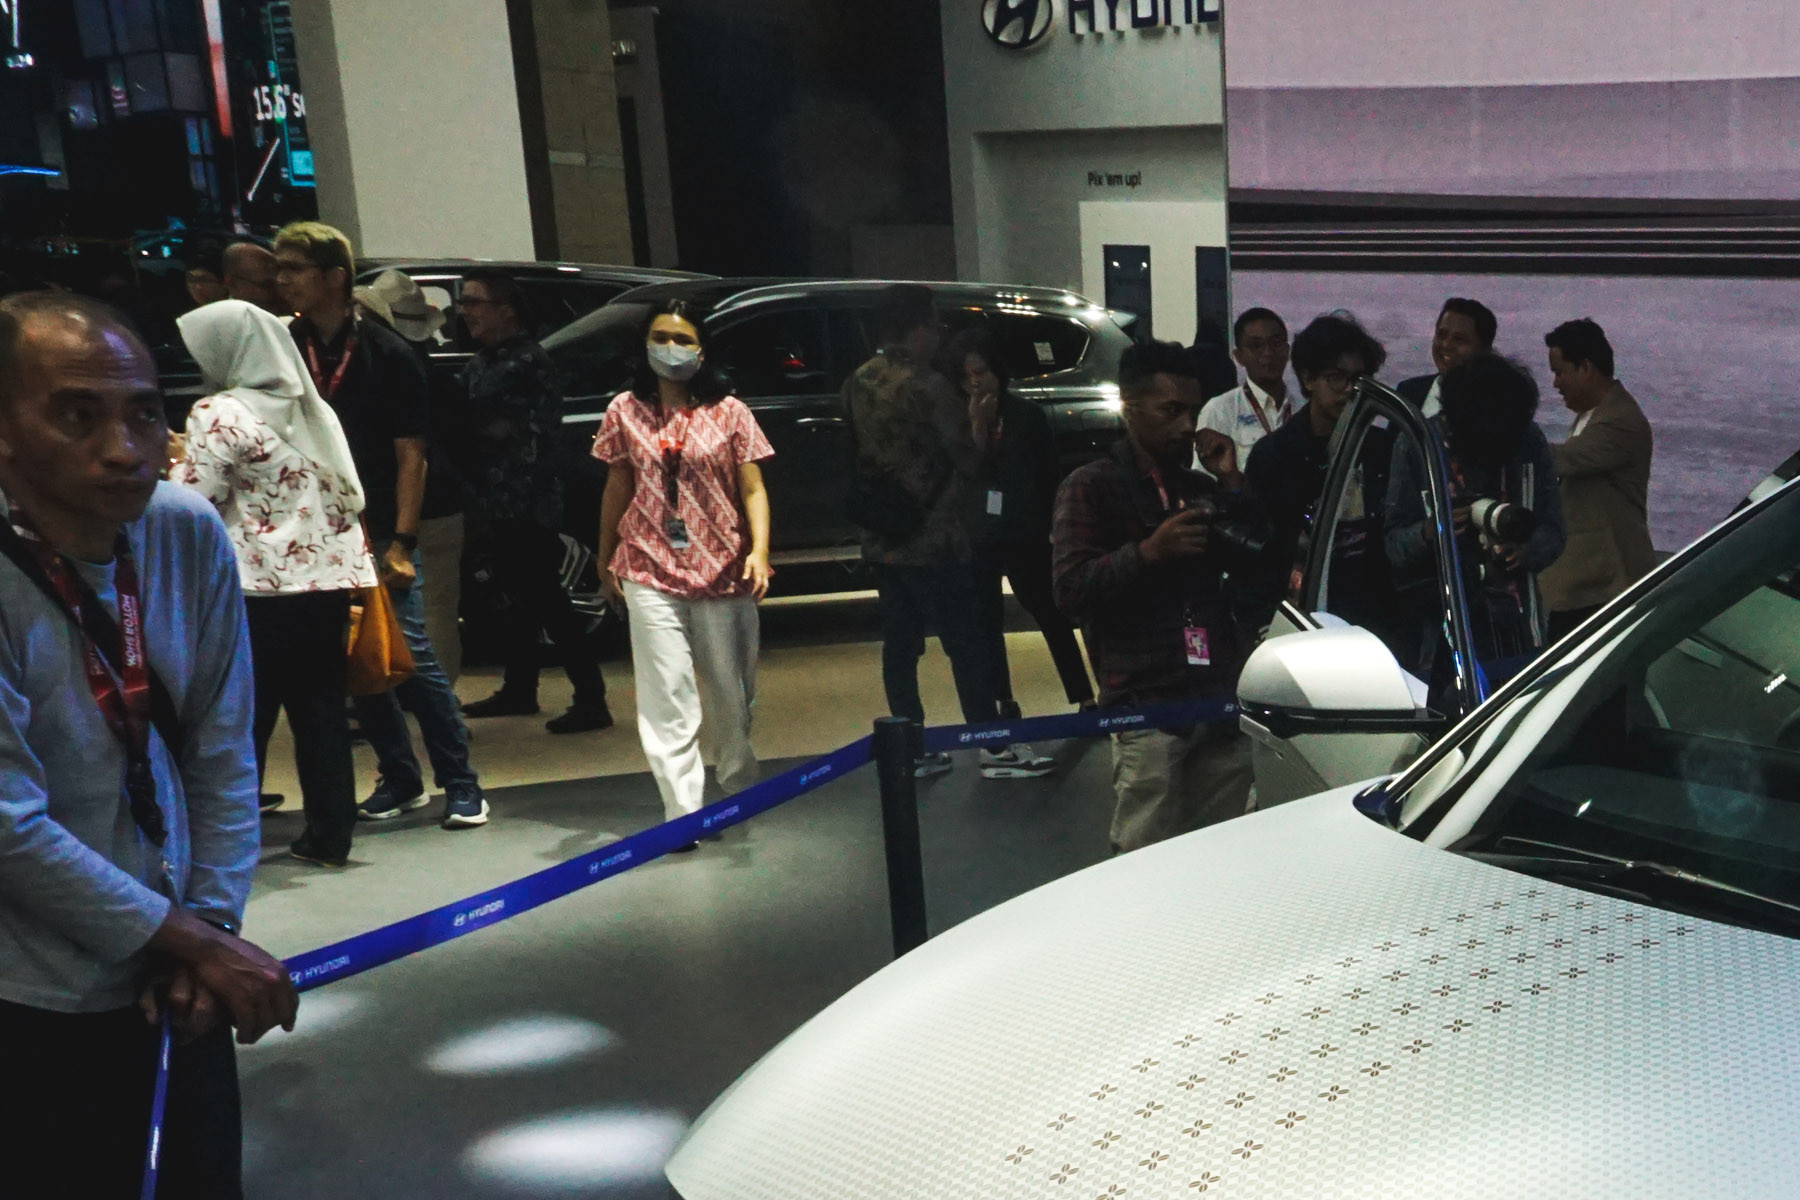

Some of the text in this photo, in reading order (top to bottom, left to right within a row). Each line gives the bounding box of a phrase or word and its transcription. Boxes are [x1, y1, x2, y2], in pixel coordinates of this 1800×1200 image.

[122, 594, 137, 667] MOTOR SHOW
[1111, 714, 1145, 725] HYUNDAI
[974, 729, 1011, 741] HYUNDAI
[468, 899, 505, 921] HYUNDAI
[305, 955, 350, 979] HYUNDAI
